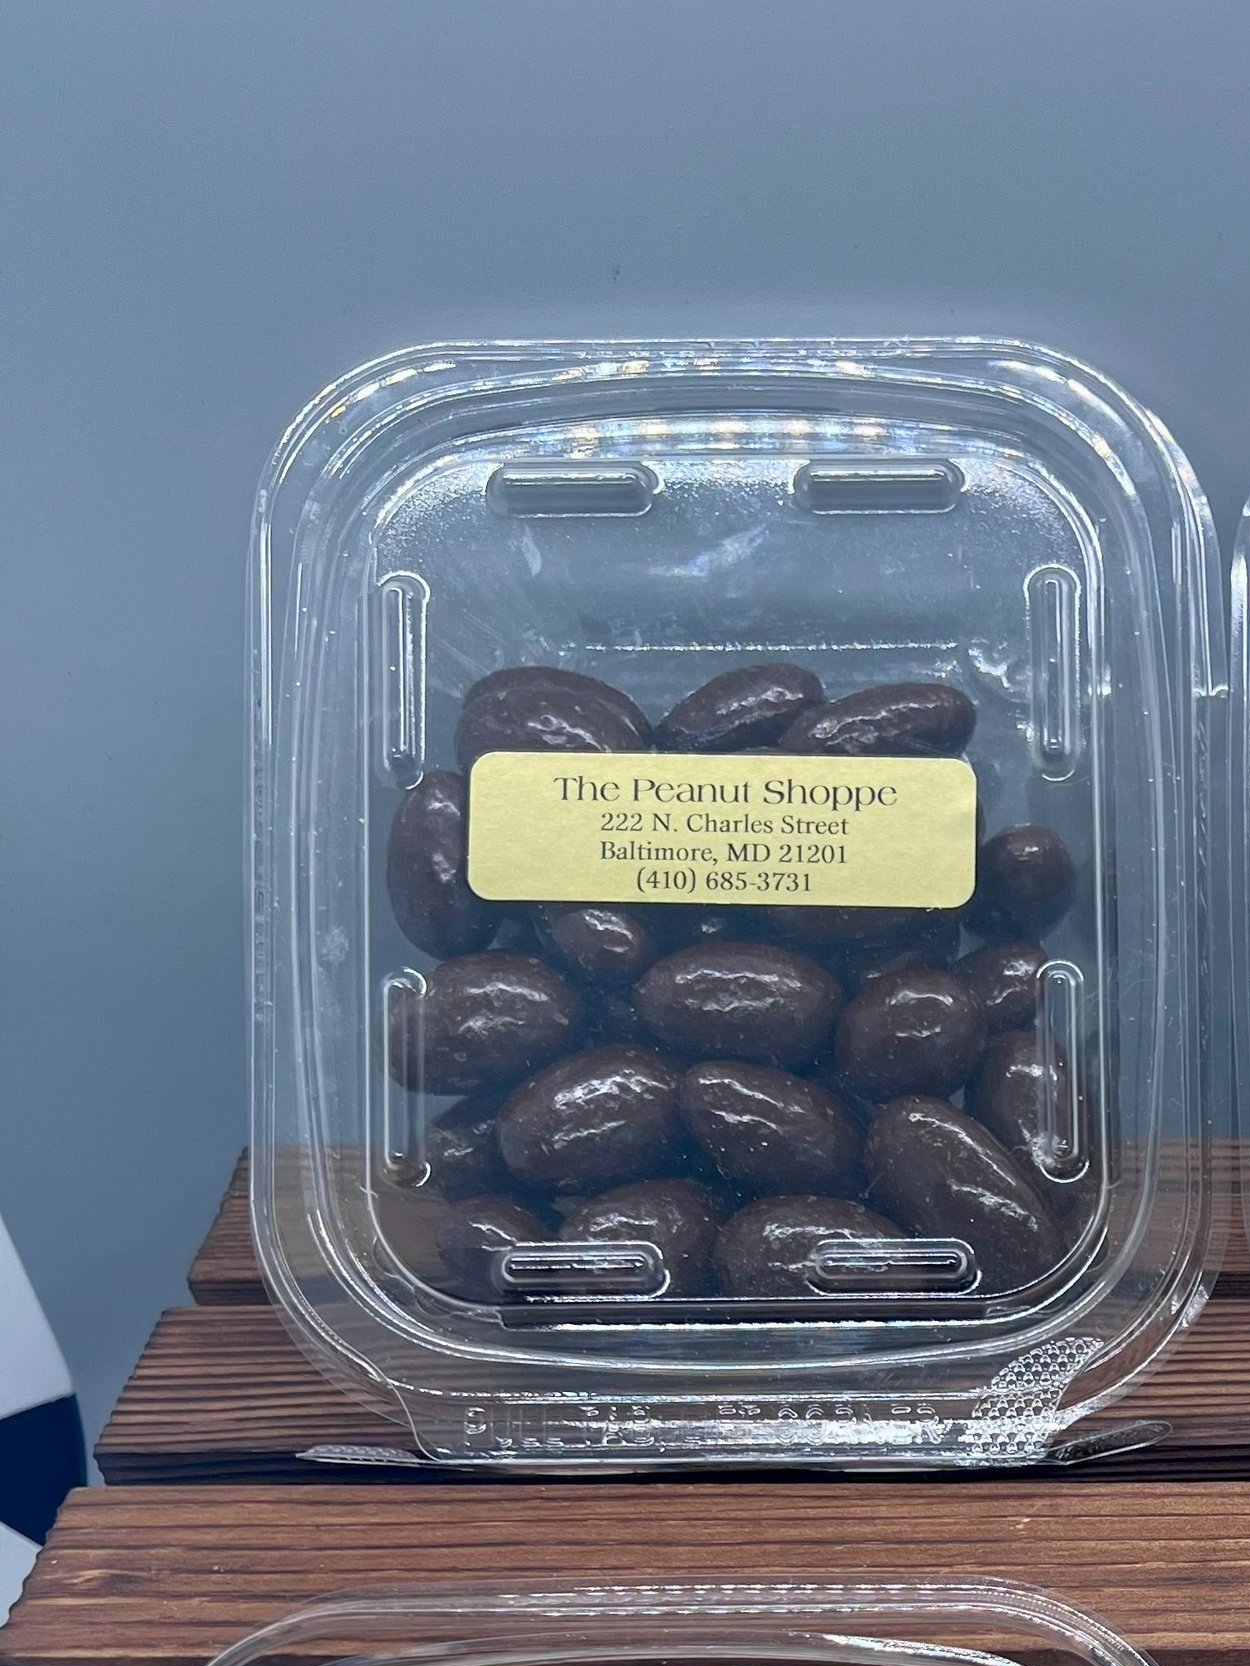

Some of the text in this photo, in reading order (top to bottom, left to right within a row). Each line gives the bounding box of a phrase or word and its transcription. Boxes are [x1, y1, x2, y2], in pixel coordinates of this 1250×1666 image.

[552, 775, 898, 813] The Peanut Shoppe
[600, 812, 850, 836] 222 N. Charles Street
[599, 840, 847, 867] Baltimore, MD 21201
[636, 866, 812, 895] (410) 685-3731
